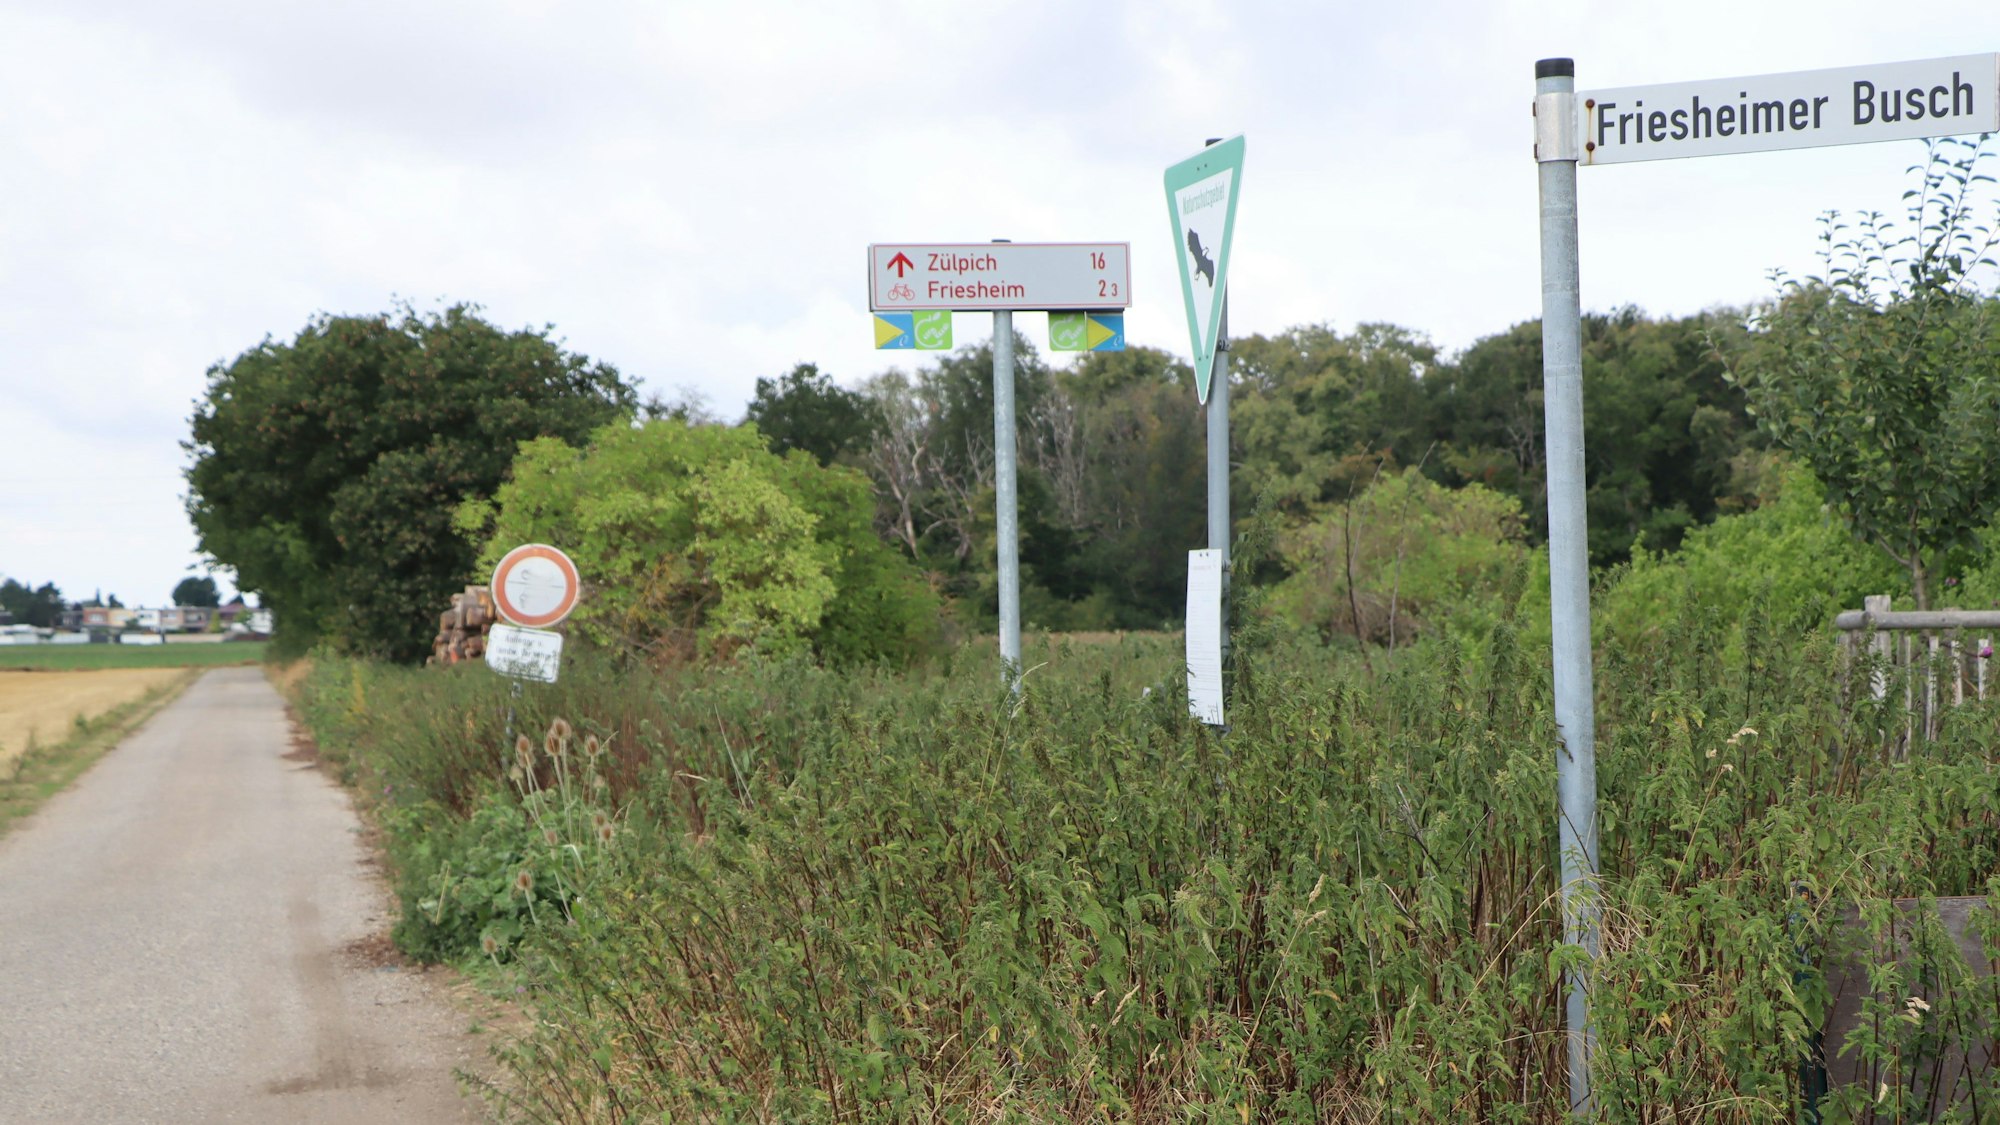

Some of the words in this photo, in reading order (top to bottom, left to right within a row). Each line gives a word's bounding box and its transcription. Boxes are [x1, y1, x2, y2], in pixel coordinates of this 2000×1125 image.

[1597, 91, 1829, 147] Friesheimer
[1852, 72, 1974, 126] Busch
[927, 253, 997, 275] Zülpich
[1090, 252, 1106, 270] 16
[927, 281, 1025, 299] Friesheim
